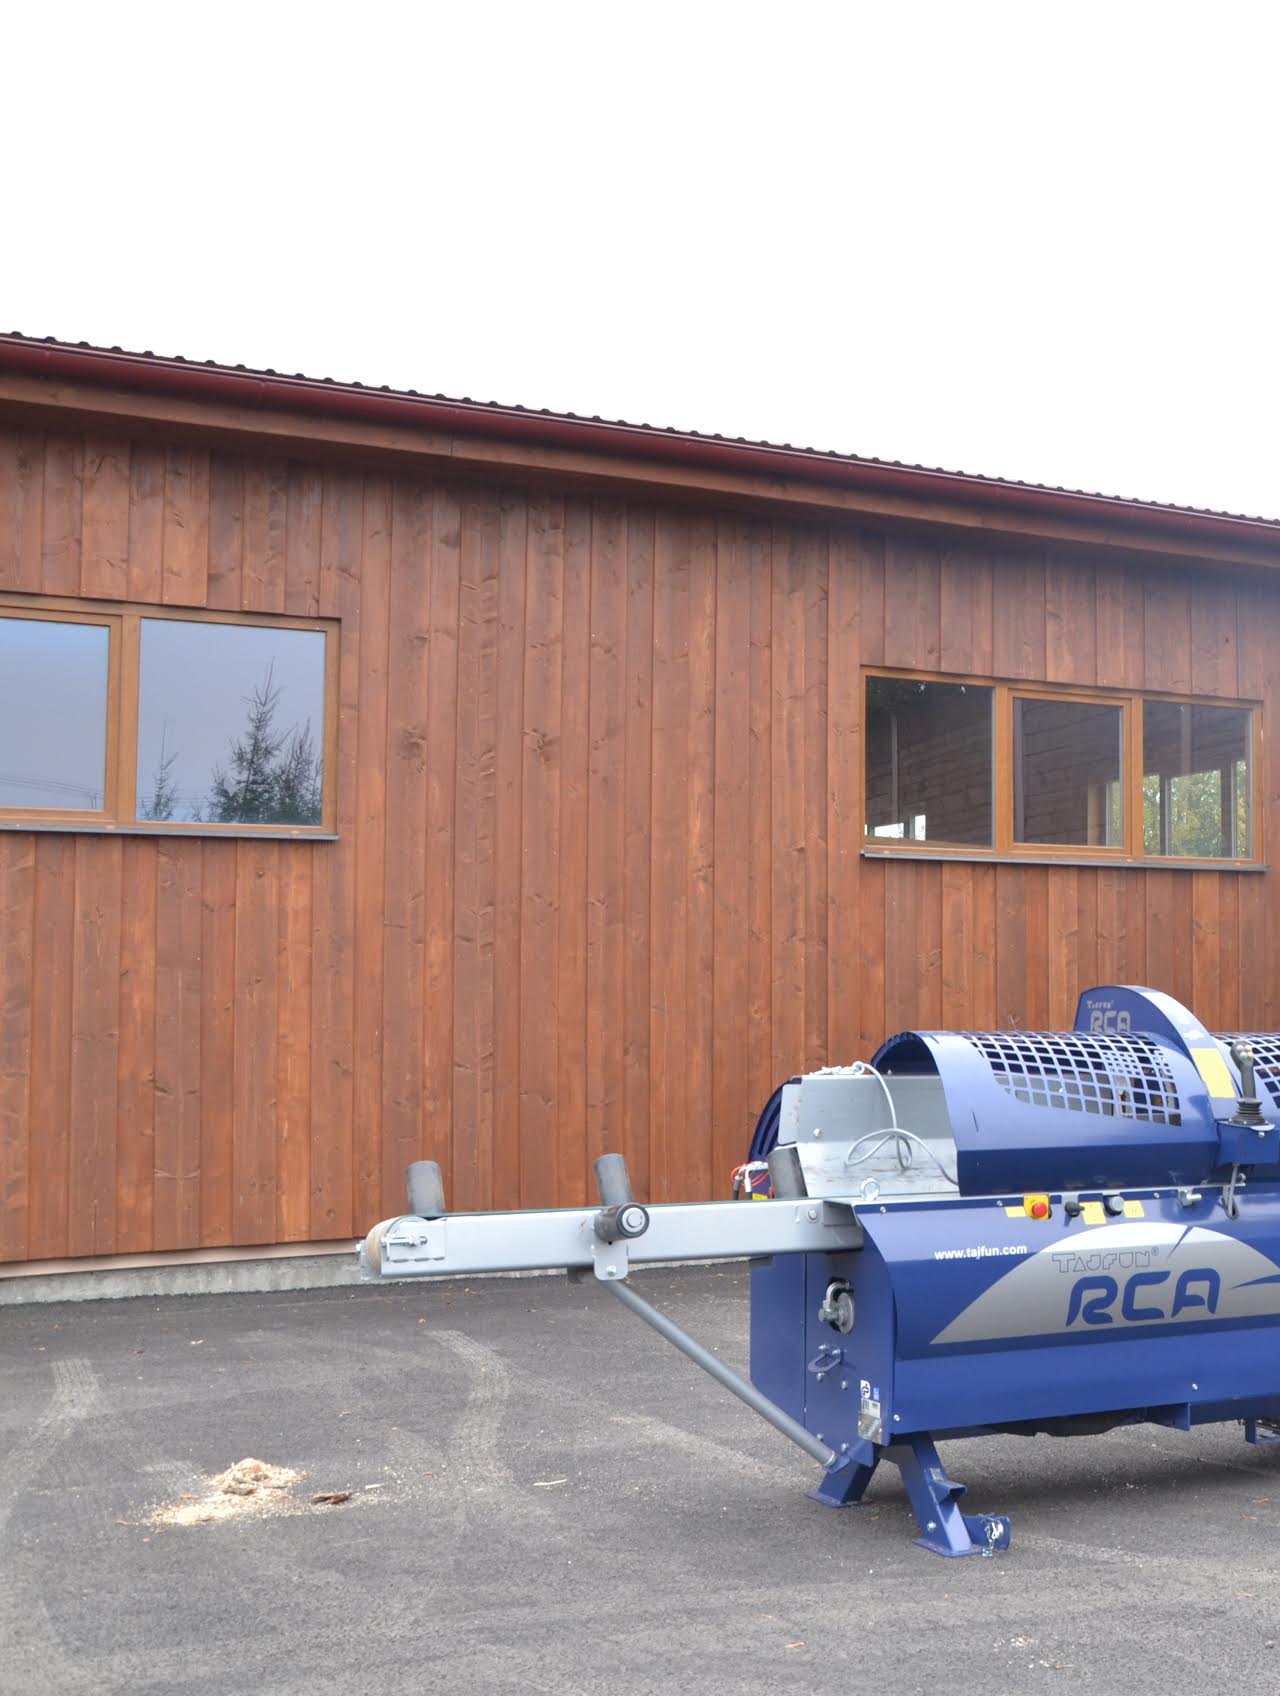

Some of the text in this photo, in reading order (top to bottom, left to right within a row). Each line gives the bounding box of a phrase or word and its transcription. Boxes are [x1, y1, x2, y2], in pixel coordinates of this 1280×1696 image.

[1090, 1010, 1131, 1033] RCA
[934, 1244, 1028, 1260] www.tajfun.com
[1065, 1267, 1221, 1328] RCA
